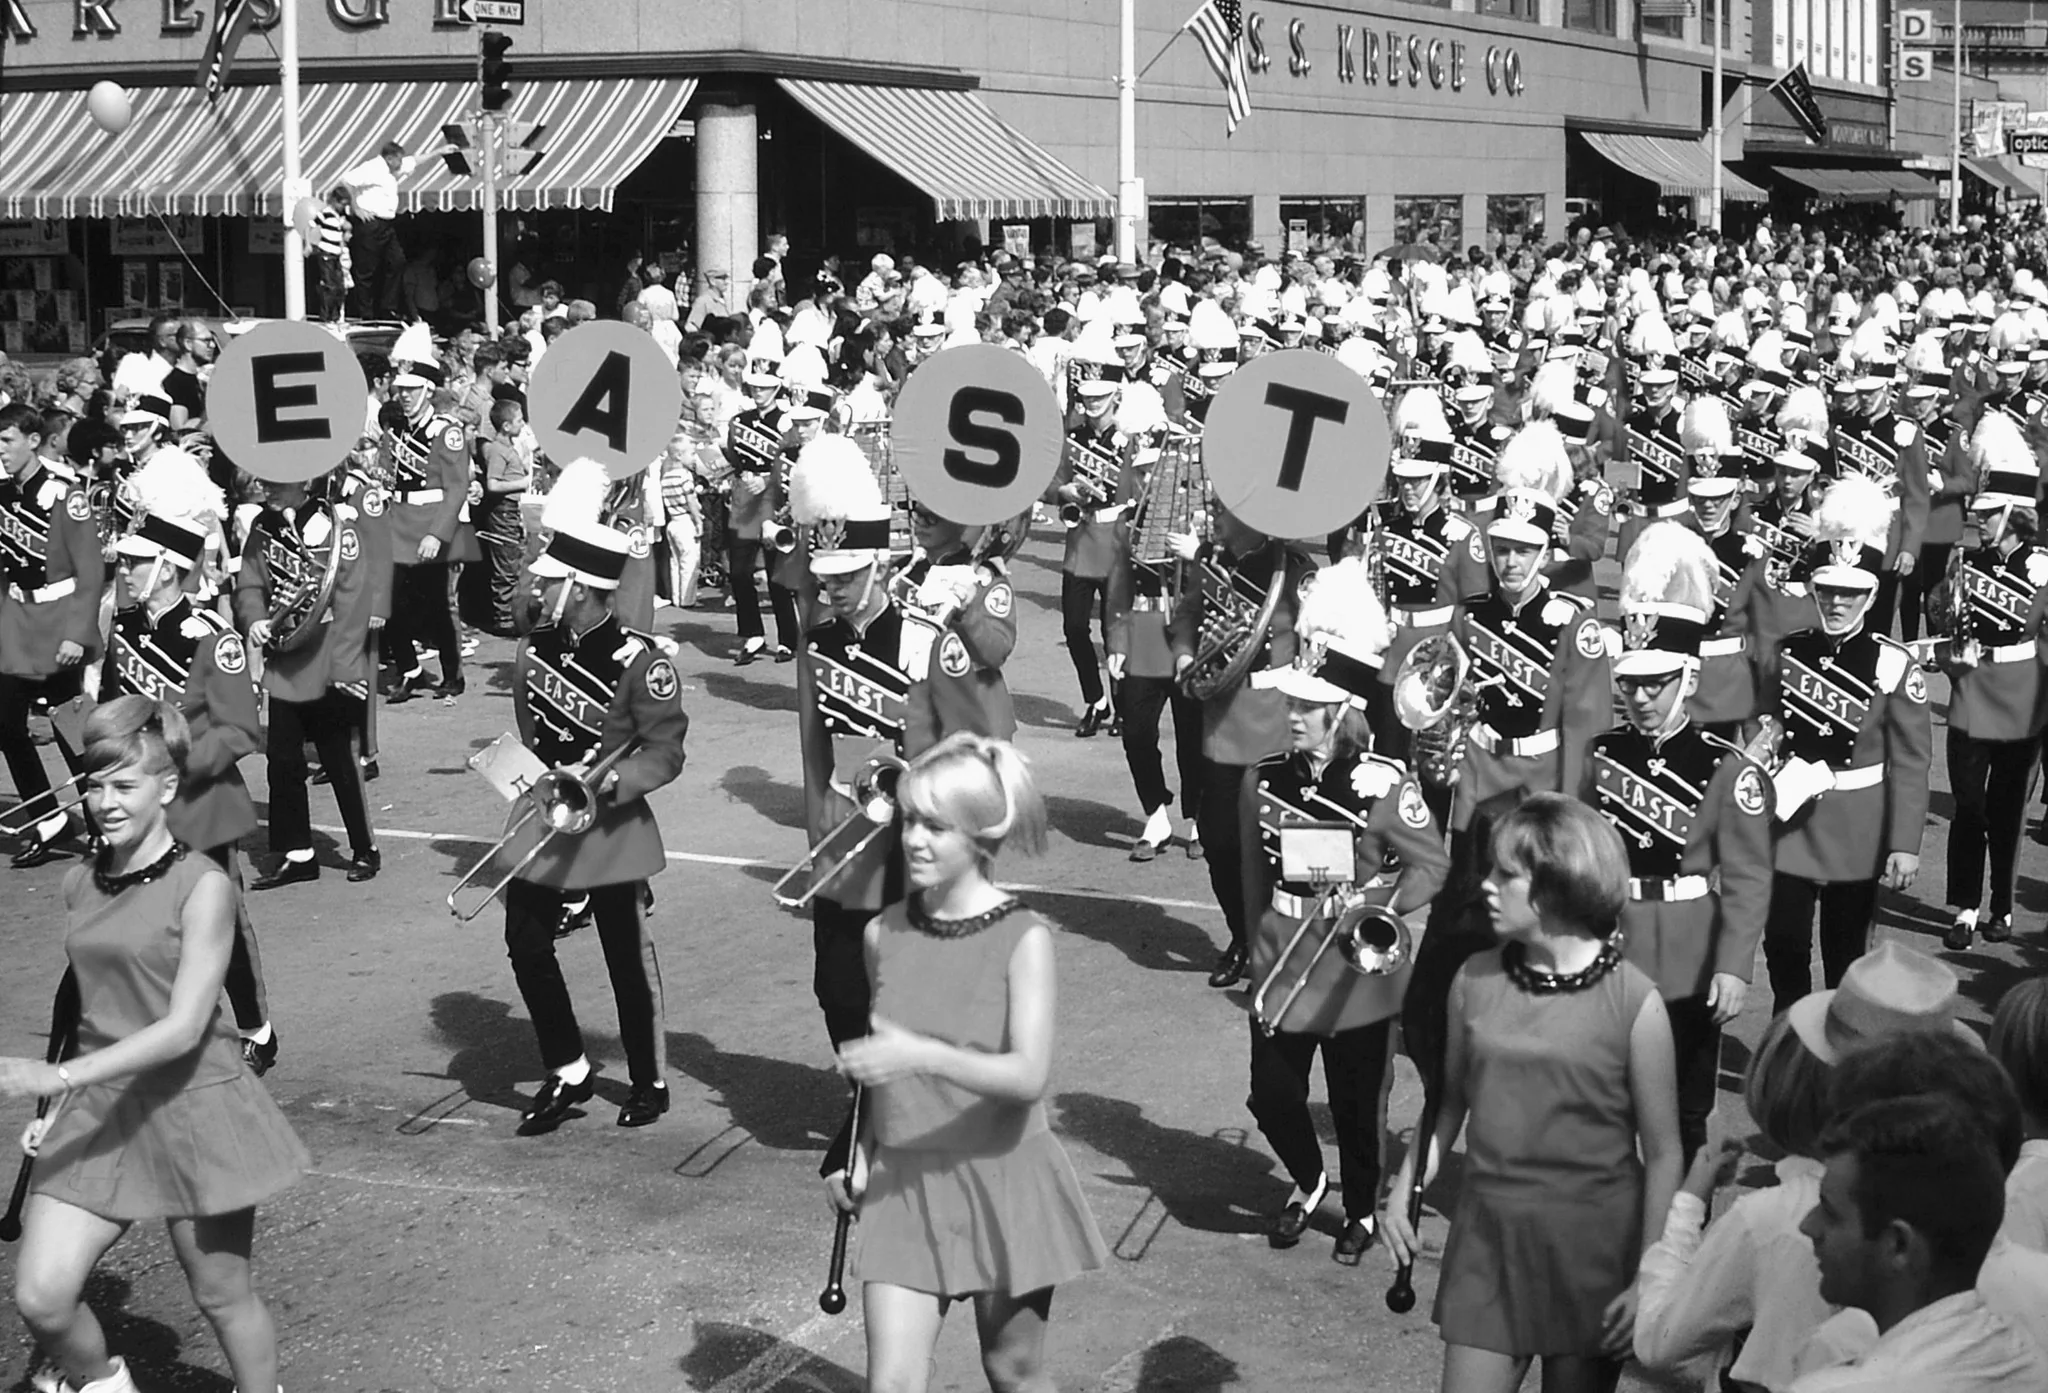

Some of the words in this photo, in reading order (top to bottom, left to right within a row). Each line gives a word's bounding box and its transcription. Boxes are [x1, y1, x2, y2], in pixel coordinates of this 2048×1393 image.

[474, 2, 494, 15] ONE
[499, 5, 519, 16] WAY
[1337, 24, 1466, 92] KRESGE
[251, 351, 331, 443] E
[556, 350, 631, 454] A
[943, 386, 1025, 488] S
[1264, 382, 1350, 492] T
[743, 430, 768, 453] EAST
[1642, 442, 1674, 468] EAST
[1747, 436, 1775, 455] EAST
[1454, 448, 1485, 470] EAST
[4, 517, 31, 547] EAST
[1766, 529, 1800, 557] EAST
[269, 544, 300, 575] EAST
[1393, 540, 1431, 571] EAST
[1977, 578, 2018, 613] EAST
[128, 656, 166, 700] EAST
[1490, 641, 1534, 685] EAST
[544, 674, 588, 720] EAST
[830, 669, 884, 714] EAST
[1800, 675, 1850, 719] EAST
[1622, 776, 1676, 829] EAST
